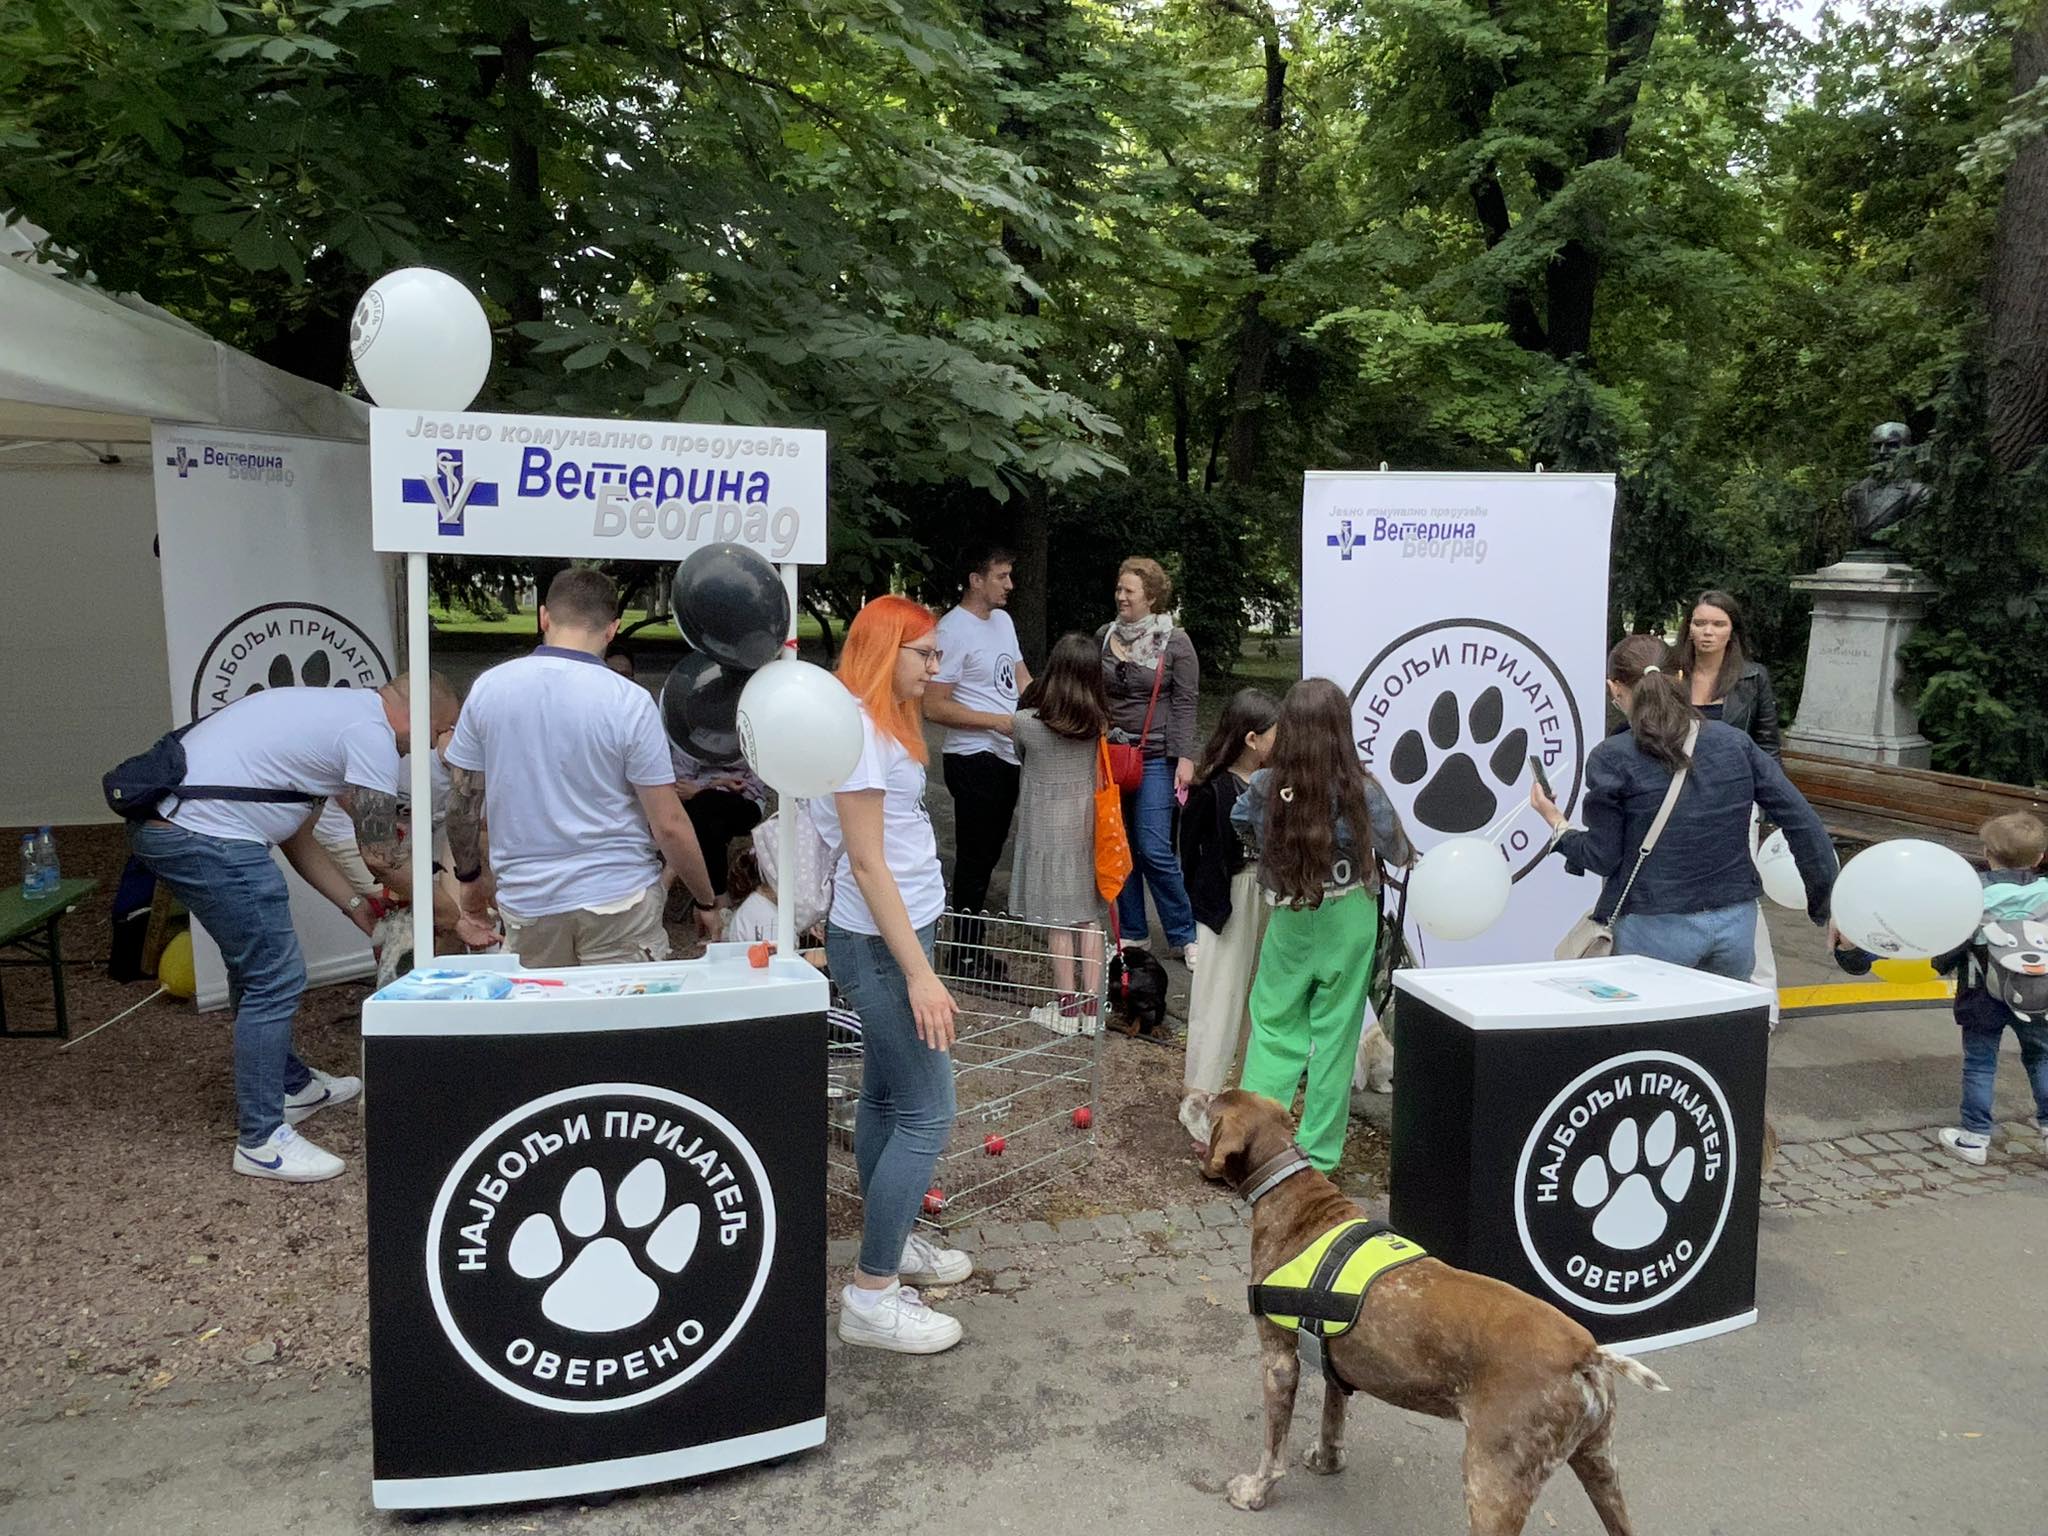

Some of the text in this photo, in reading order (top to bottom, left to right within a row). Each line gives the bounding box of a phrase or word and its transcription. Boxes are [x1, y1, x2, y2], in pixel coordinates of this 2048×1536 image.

[406, 415, 801, 459] Јавно комунално предузеће
[517, 446, 770, 508] Ветерина
[593, 485, 800, 558] Београд
[211, 619, 379, 711] АЈБОЉИ ПРИЈАТЕ
[1461, 642, 1563, 767] ПРИЈАТЕЉ
[1537, 1072, 1721, 1202] НАЈБОЉИ ПРИЈАТЕЉ
[458, 1111, 747, 1271] НАЈБОЉИ ПРИЈАТЕЉ
[1566, 1239, 1693, 1293] ОВЕРЕНО
[506, 1319, 704, 1386] ОВЕРЕНО
